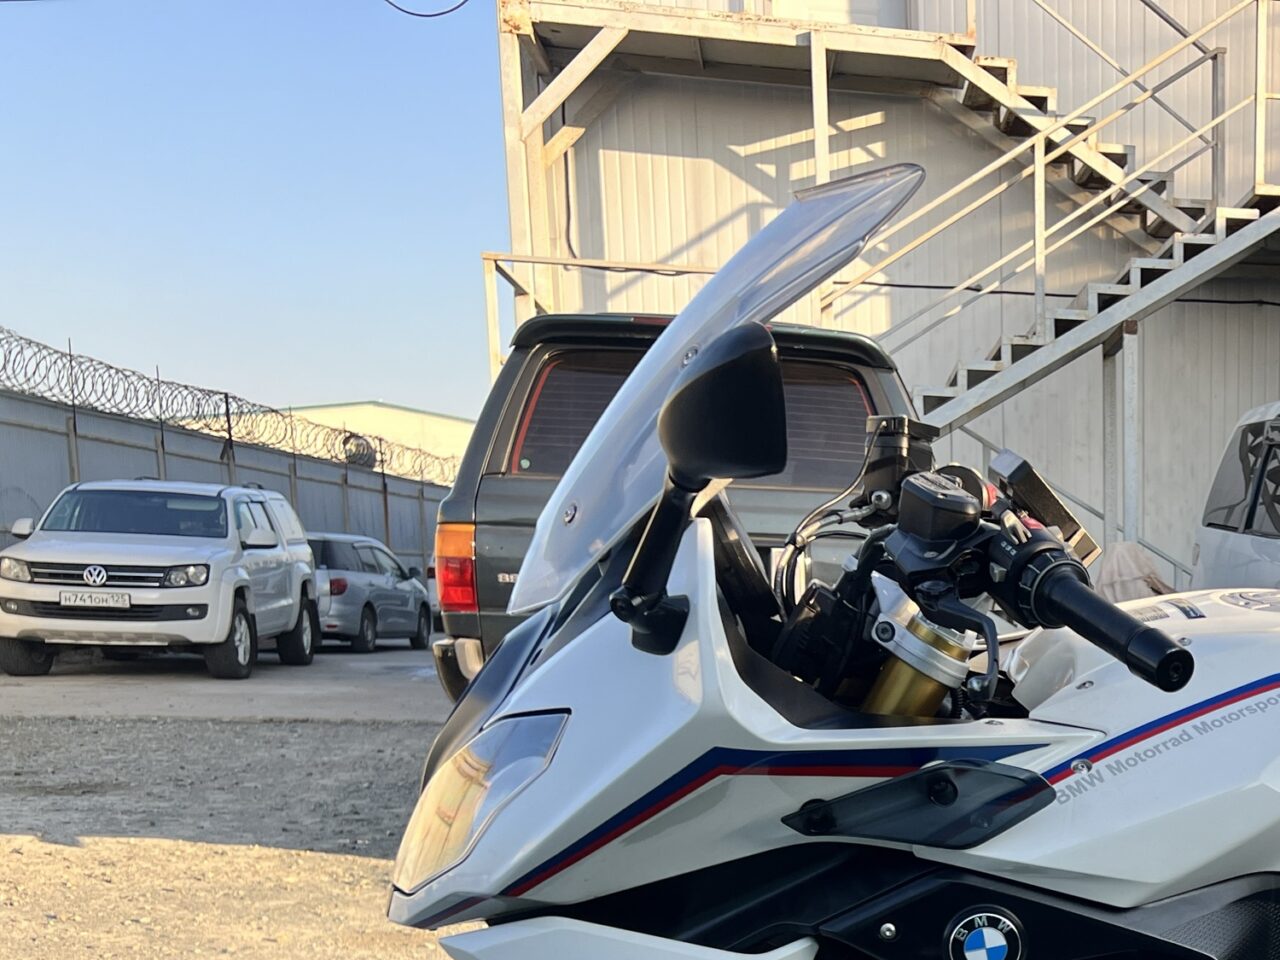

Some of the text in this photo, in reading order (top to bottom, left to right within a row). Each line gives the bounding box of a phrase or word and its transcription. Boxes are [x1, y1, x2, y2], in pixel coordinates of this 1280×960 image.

[1056, 770, 1105, 805] BMW
[1105, 729, 1194, 776] Motorrad
[955, 916, 1012, 941] BMW
